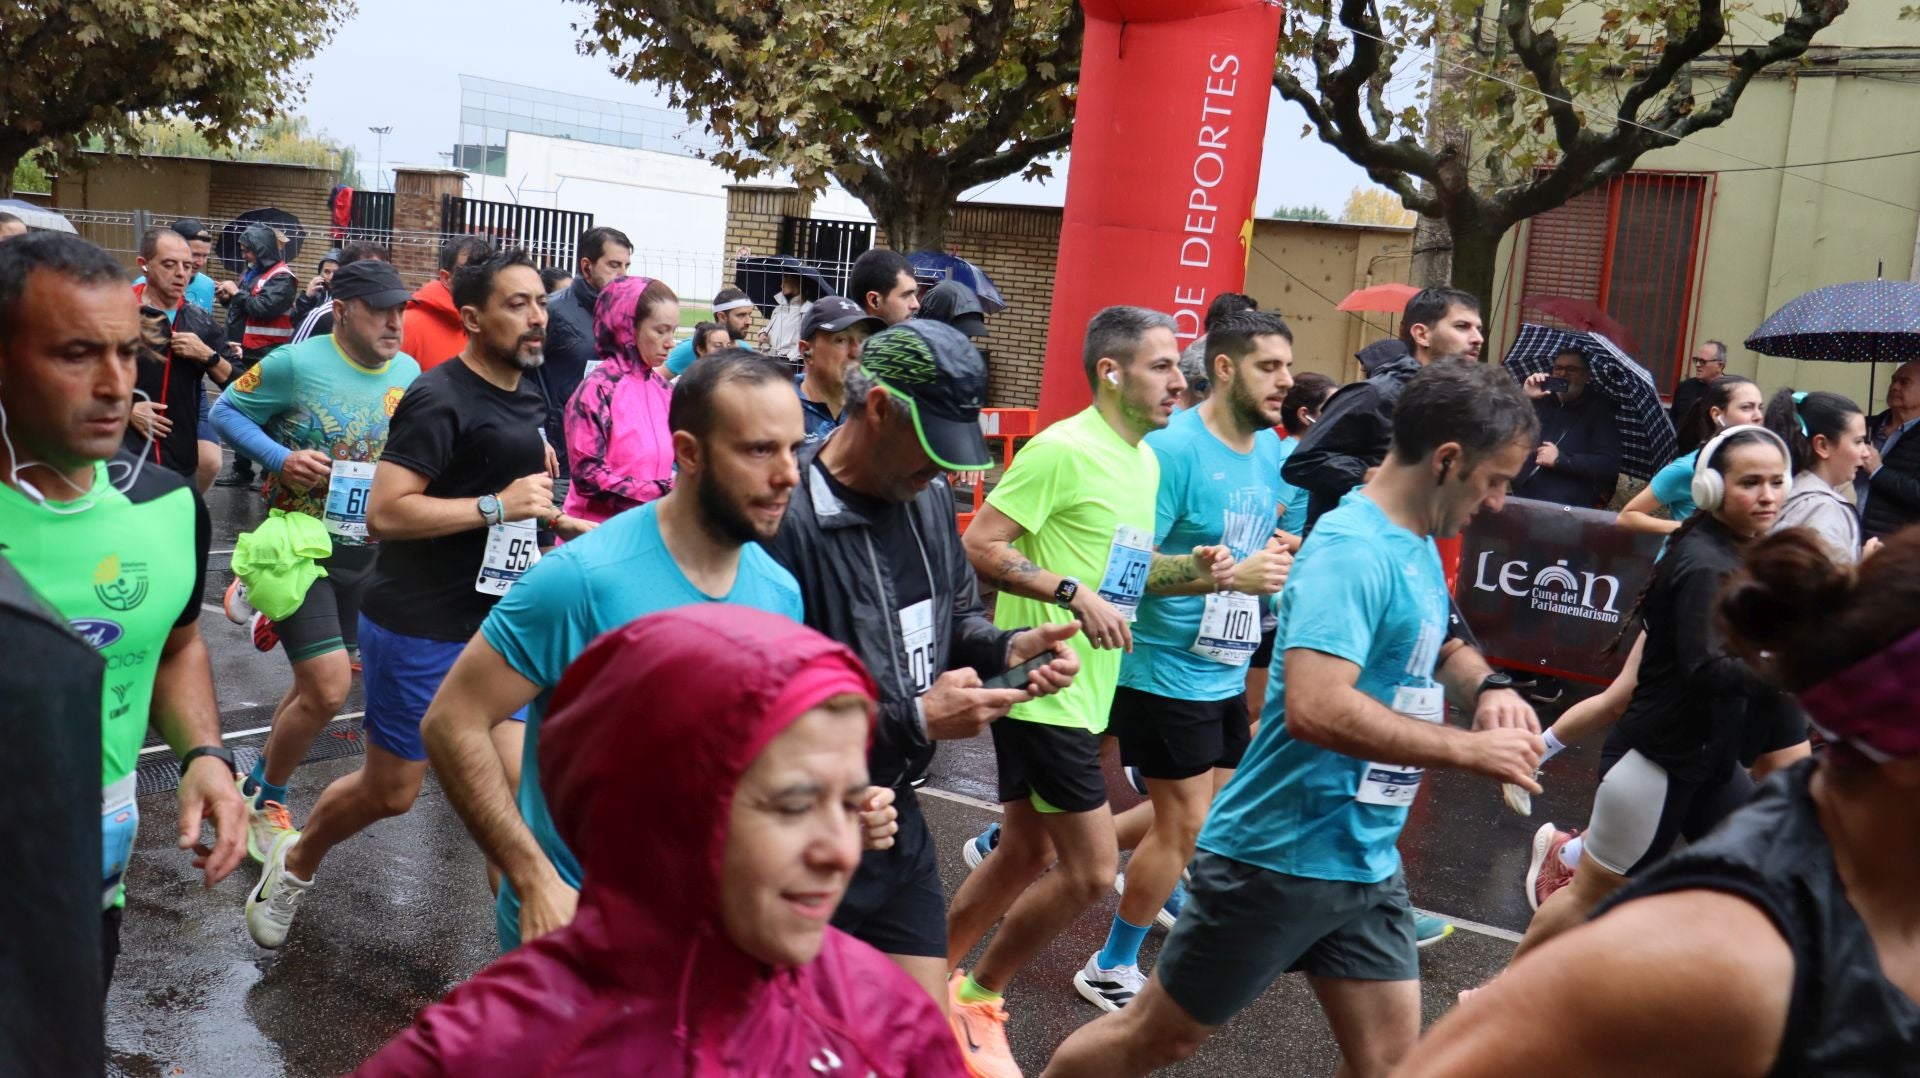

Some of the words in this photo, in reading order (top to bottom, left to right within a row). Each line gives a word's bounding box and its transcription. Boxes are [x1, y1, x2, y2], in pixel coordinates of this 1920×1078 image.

[1179, 53, 1240, 268] DEPORTES
[1173, 285, 1205, 340] DE
[1118, 560, 1147, 596] 450
[1531, 587, 1558, 601] Cuna
[1561, 591, 1578, 605] del
[1531, 598, 1619, 624] Parlamentarismo
[1223, 609, 1253, 641] 1101
